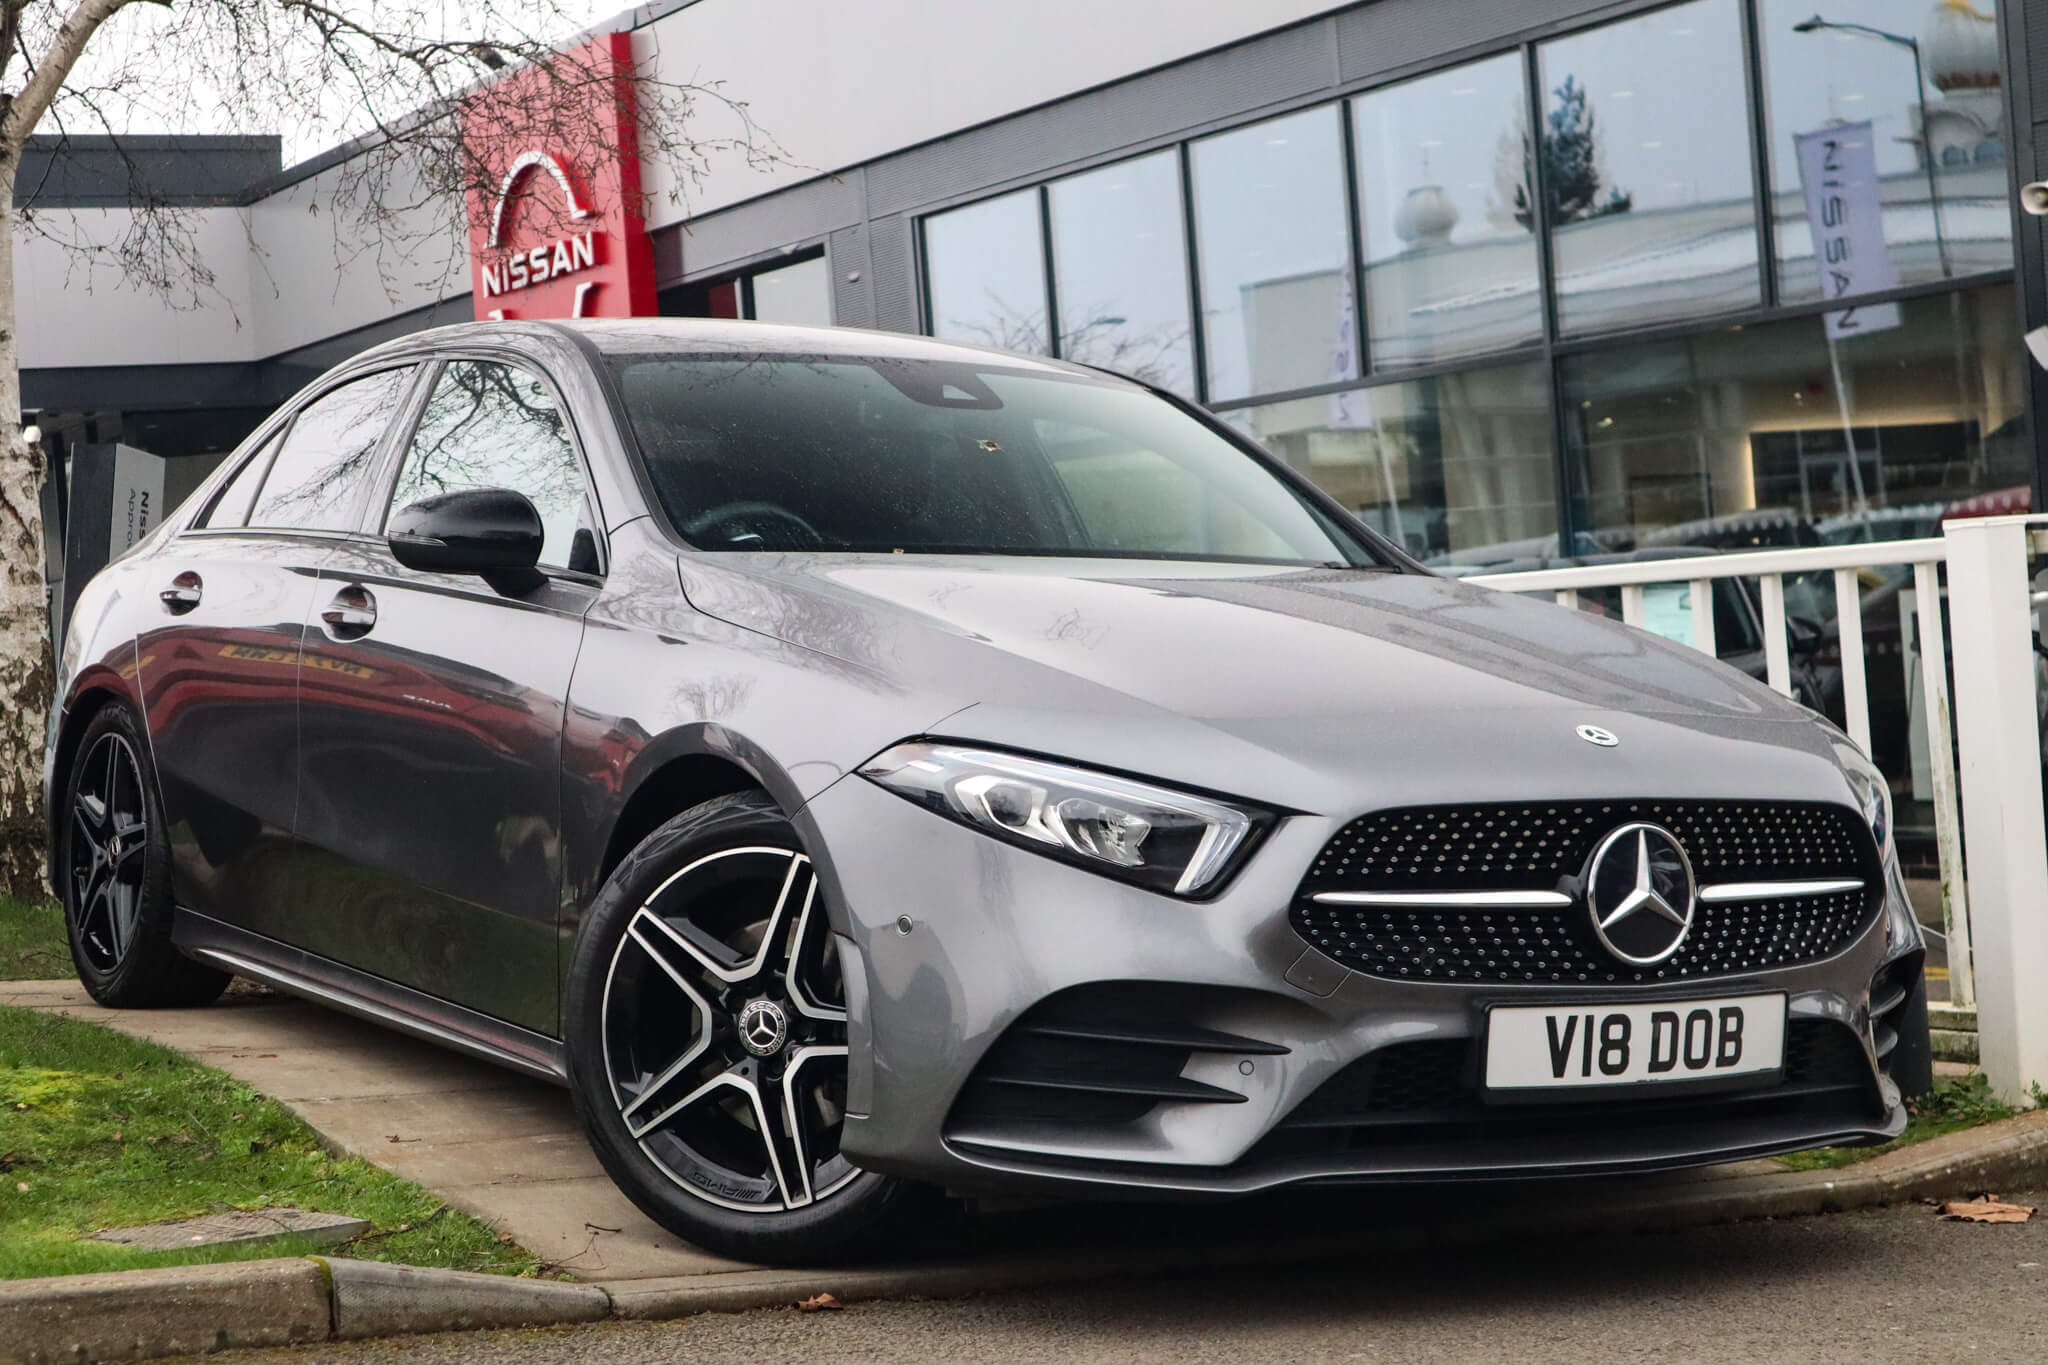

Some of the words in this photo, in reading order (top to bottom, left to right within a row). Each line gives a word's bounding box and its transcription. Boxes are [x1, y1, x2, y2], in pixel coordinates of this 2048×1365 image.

[482, 231, 594, 298] NISSAN
[1822, 140, 1860, 330] NISSAN
[1545, 1014, 1632, 1078] V18
[1648, 1006, 1744, 1073] DOB
